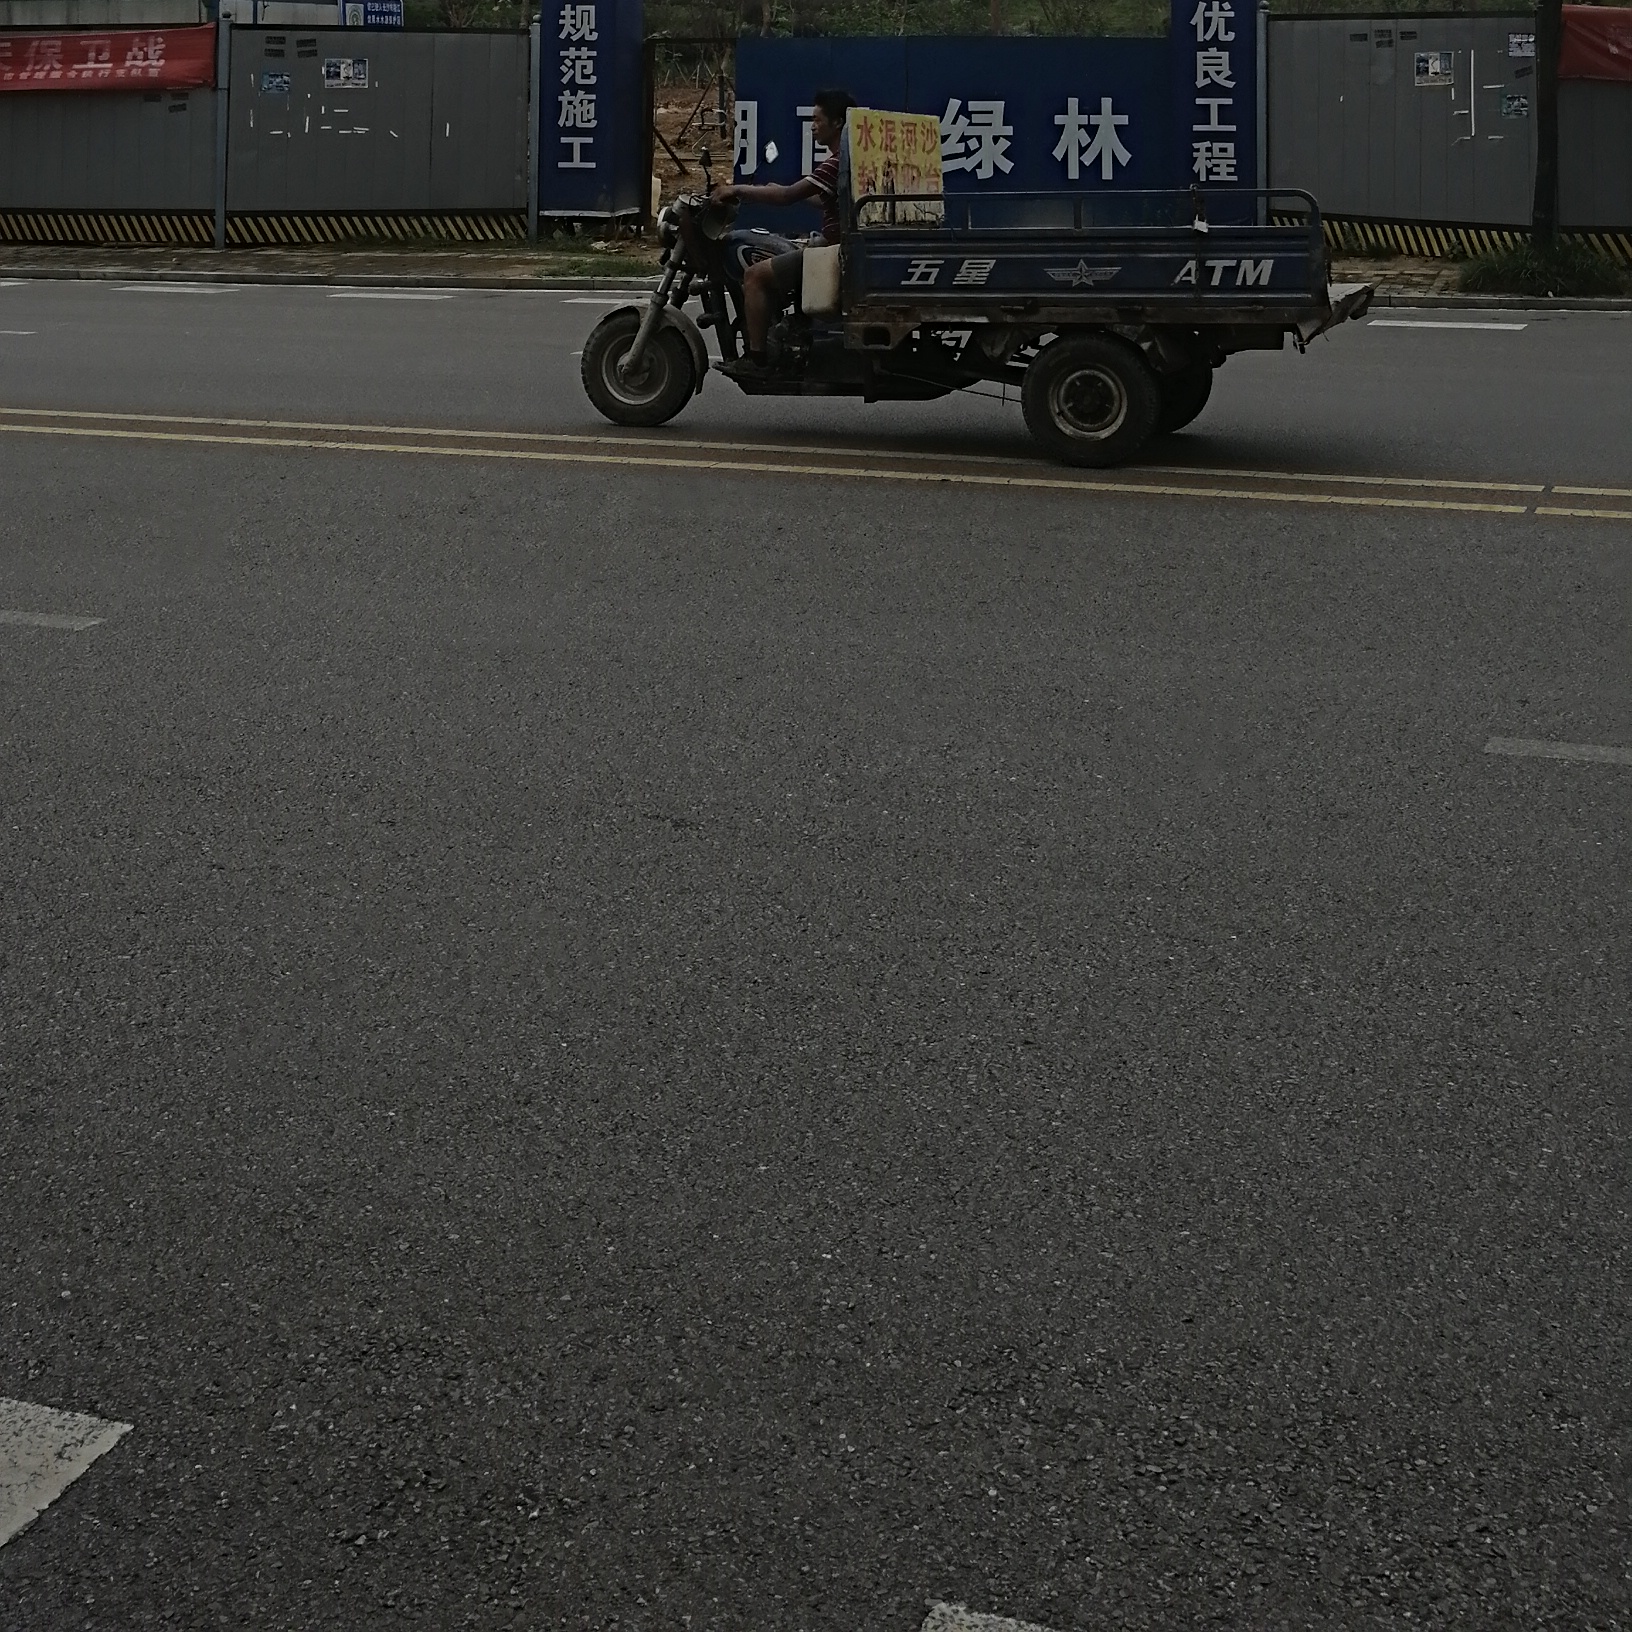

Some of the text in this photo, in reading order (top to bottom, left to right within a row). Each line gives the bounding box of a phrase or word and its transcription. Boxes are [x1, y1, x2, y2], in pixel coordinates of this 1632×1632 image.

[856, 116, 938, 155] 水泥河沙
[900, 258, 997, 287] 五星
[1170, 258, 1275, 287] ATM
